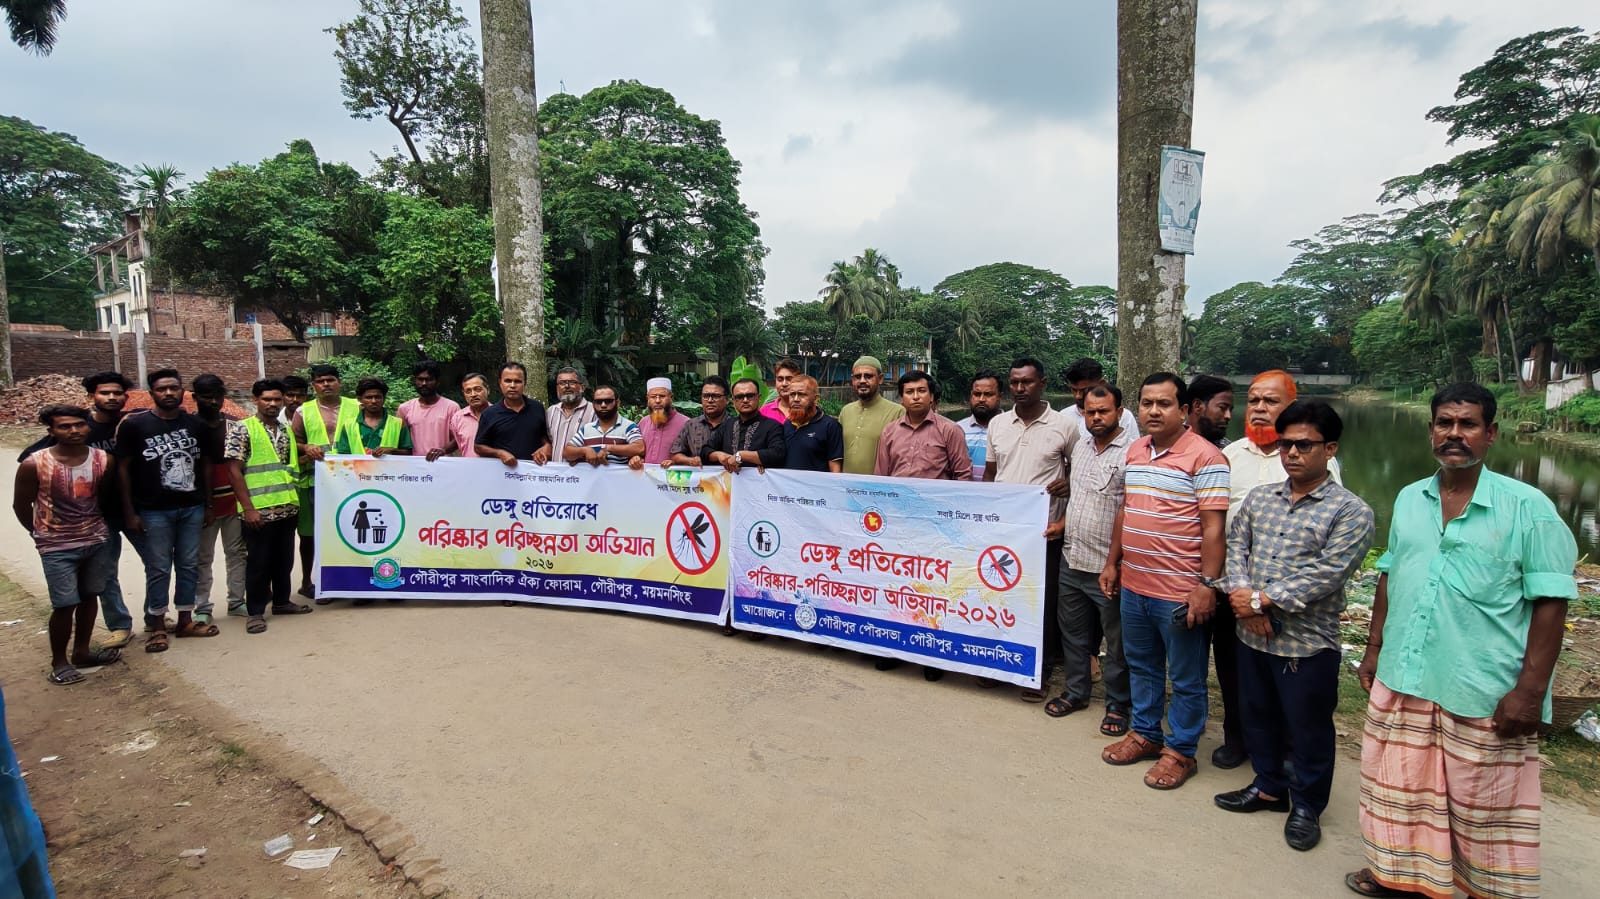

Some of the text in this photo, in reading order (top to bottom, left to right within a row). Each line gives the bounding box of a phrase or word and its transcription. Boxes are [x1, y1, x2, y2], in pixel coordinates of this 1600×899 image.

[142, 437, 198, 461] SPEED
[144, 428, 190, 448] BEAST
[481, 495, 599, 521] ডেঙ্গু প্রতিরোধে
[418, 519, 656, 558] পরিষ্কার পরিচ্ছন্নতা অভিযান
[525, 556, 554, 570] ২০২৬
[800, 542, 952, 584] ডেঙ্গু প্রতিরোধে
[409, 569, 457, 588] গৌরীপুর
[460, 570, 515, 588] সাংবাদিক
[518, 572, 540, 590] ঐক্য
[641, 584, 693, 606] ময়মনসিংহ
[883, 585, 1016, 629] অভিযান-২০২৬
[741, 604, 786, 621] আয়োজনে
[818, 613, 857, 635] গৌরীপুর
[961, 641, 1023, 666] ময়মনসিংহ
